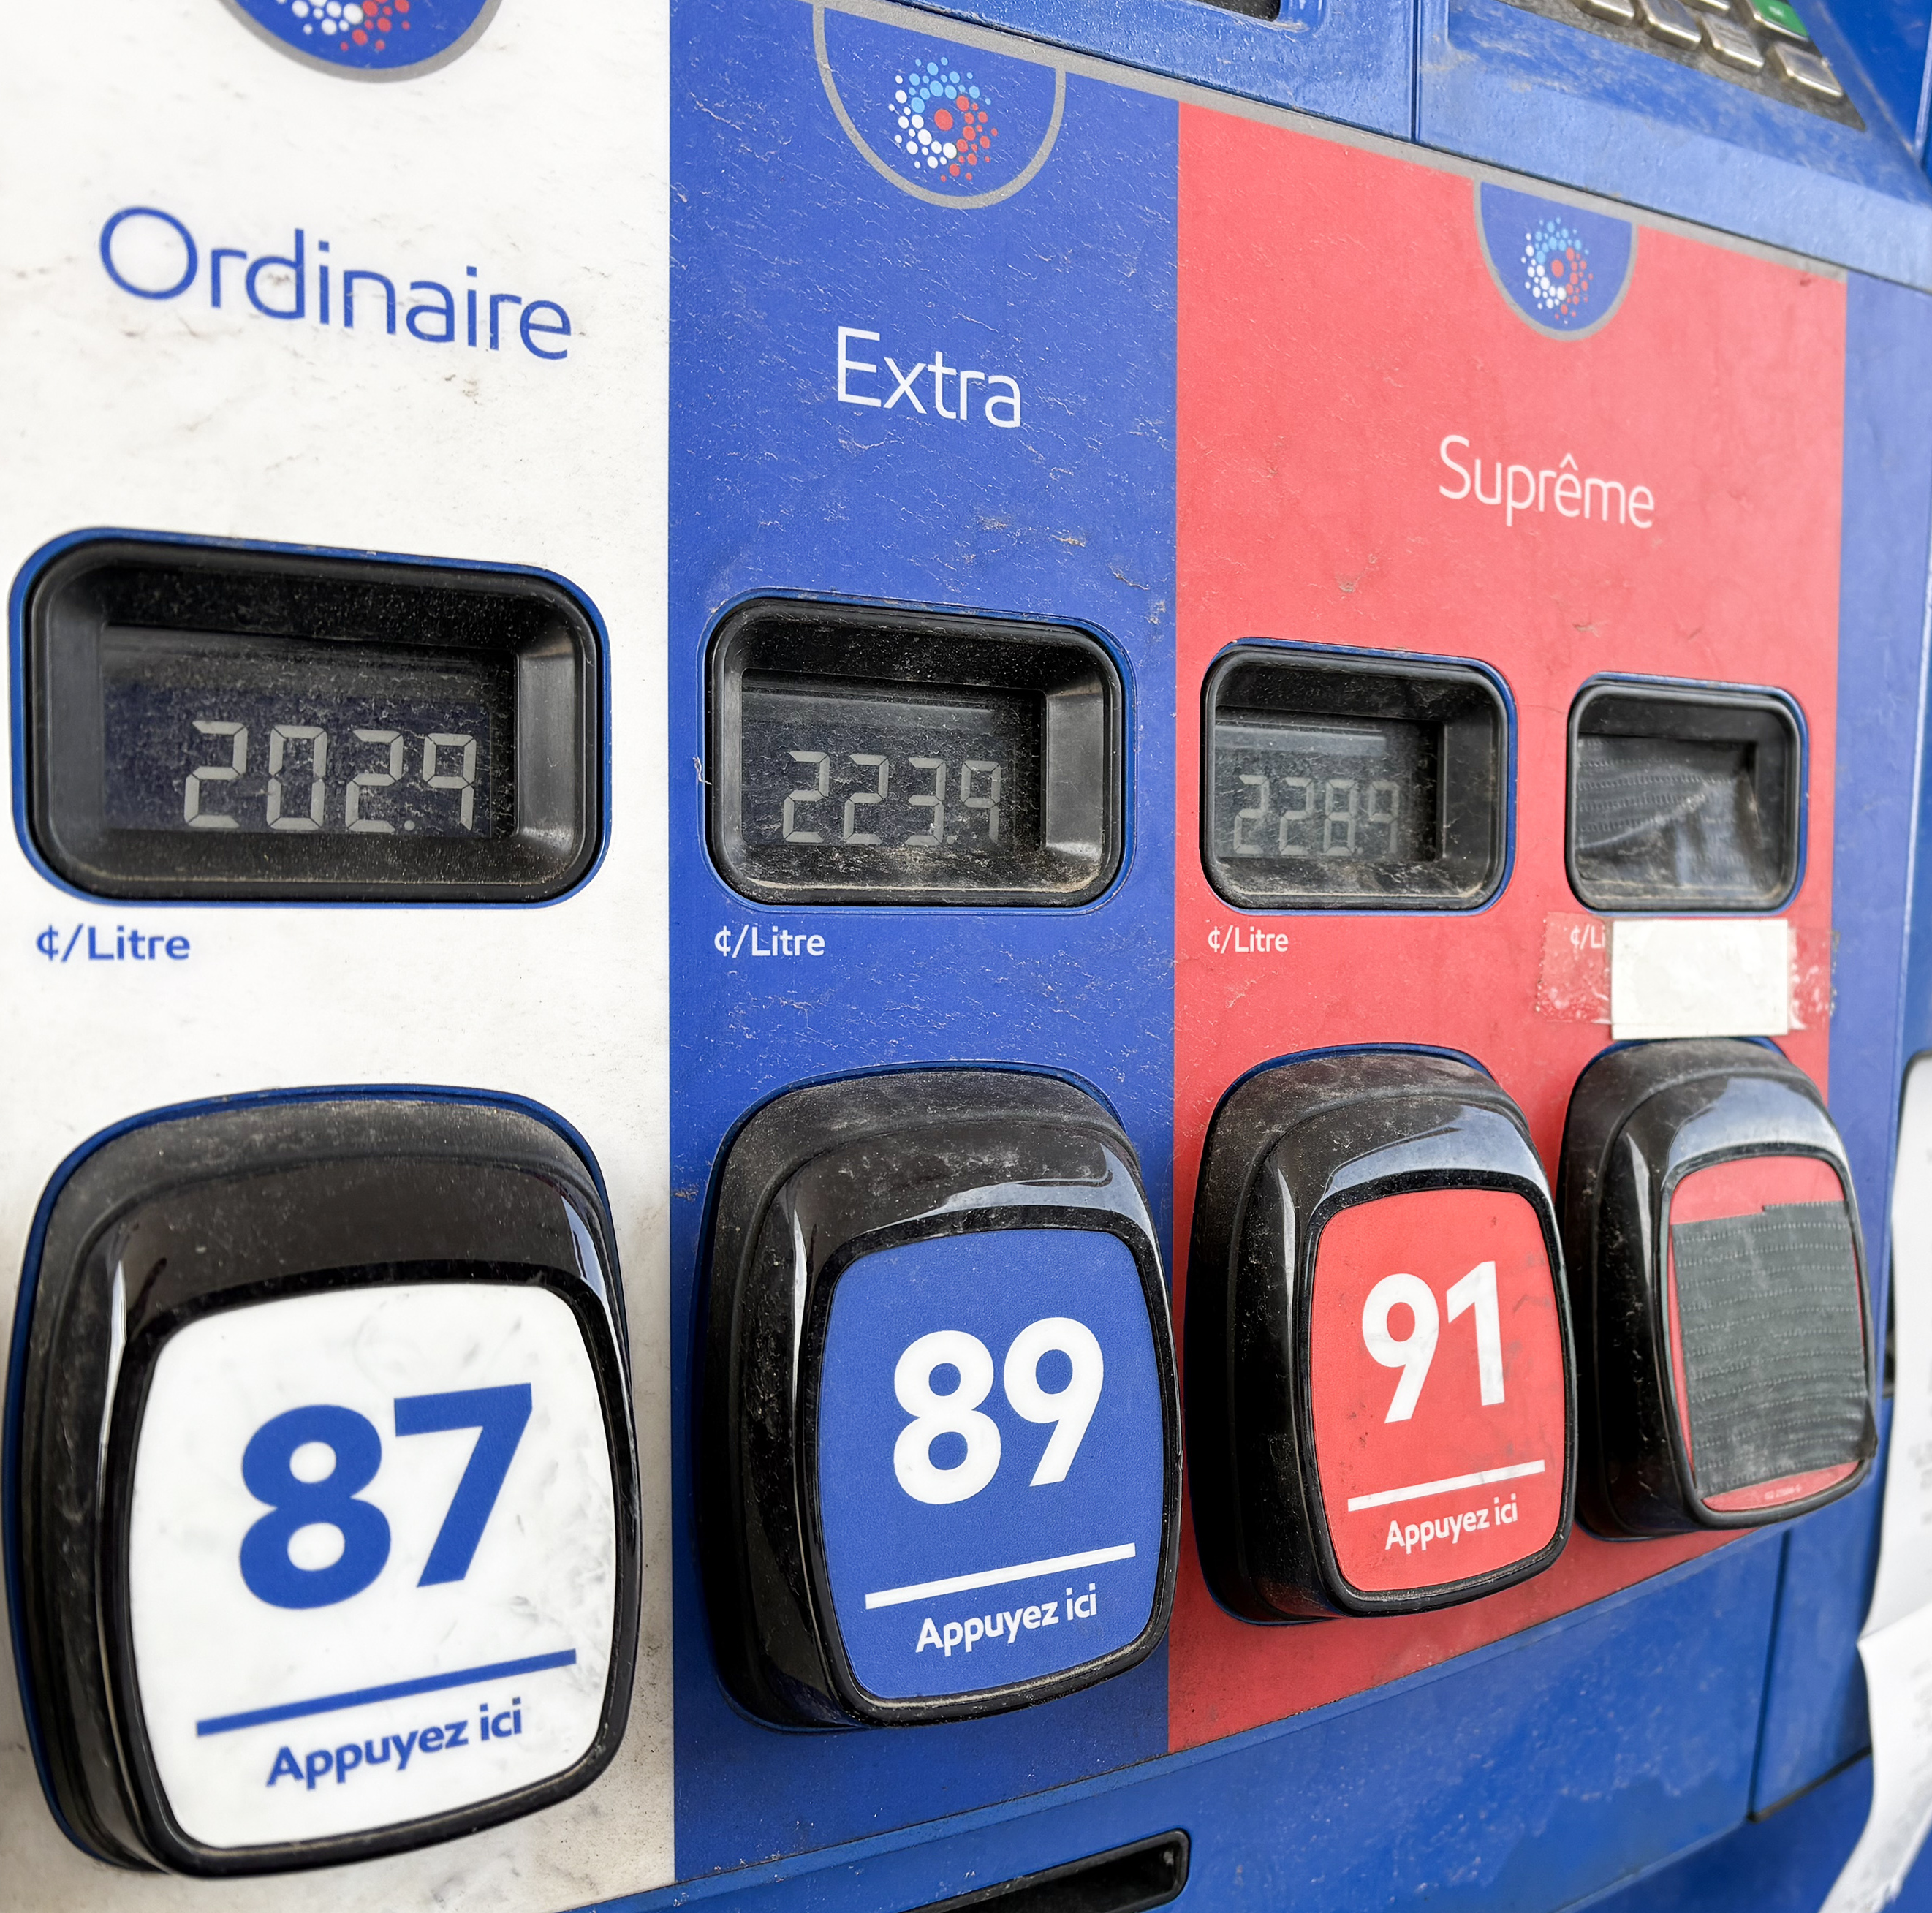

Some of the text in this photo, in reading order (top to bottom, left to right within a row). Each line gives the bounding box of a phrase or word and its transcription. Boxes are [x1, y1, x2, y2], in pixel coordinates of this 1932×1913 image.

[99, 205, 572, 360] Ordinaire
[838, 325, 1021, 428] Extra
[1439, 434, 1655, 529] Suprême
[183, 720, 477, 833] 202.9
[36, 923, 191, 963] ¢/Litre
[713, 924, 826, 958] ¢/Litre
[1208, 925, 1289, 955] ¢/Litre
[1569, 923, 1606, 950] ¢/Li
[1362, 1260, 1506, 1424] 91
[893, 1317, 1105, 1505] 89
[239, 1382, 533, 1610] 87
[1384, 1493, 1518, 1555] Appuyez ici
[915, 1582, 1098, 1657] Appuyez ici
[265, 1696, 523, 1791] Appuyez ici
